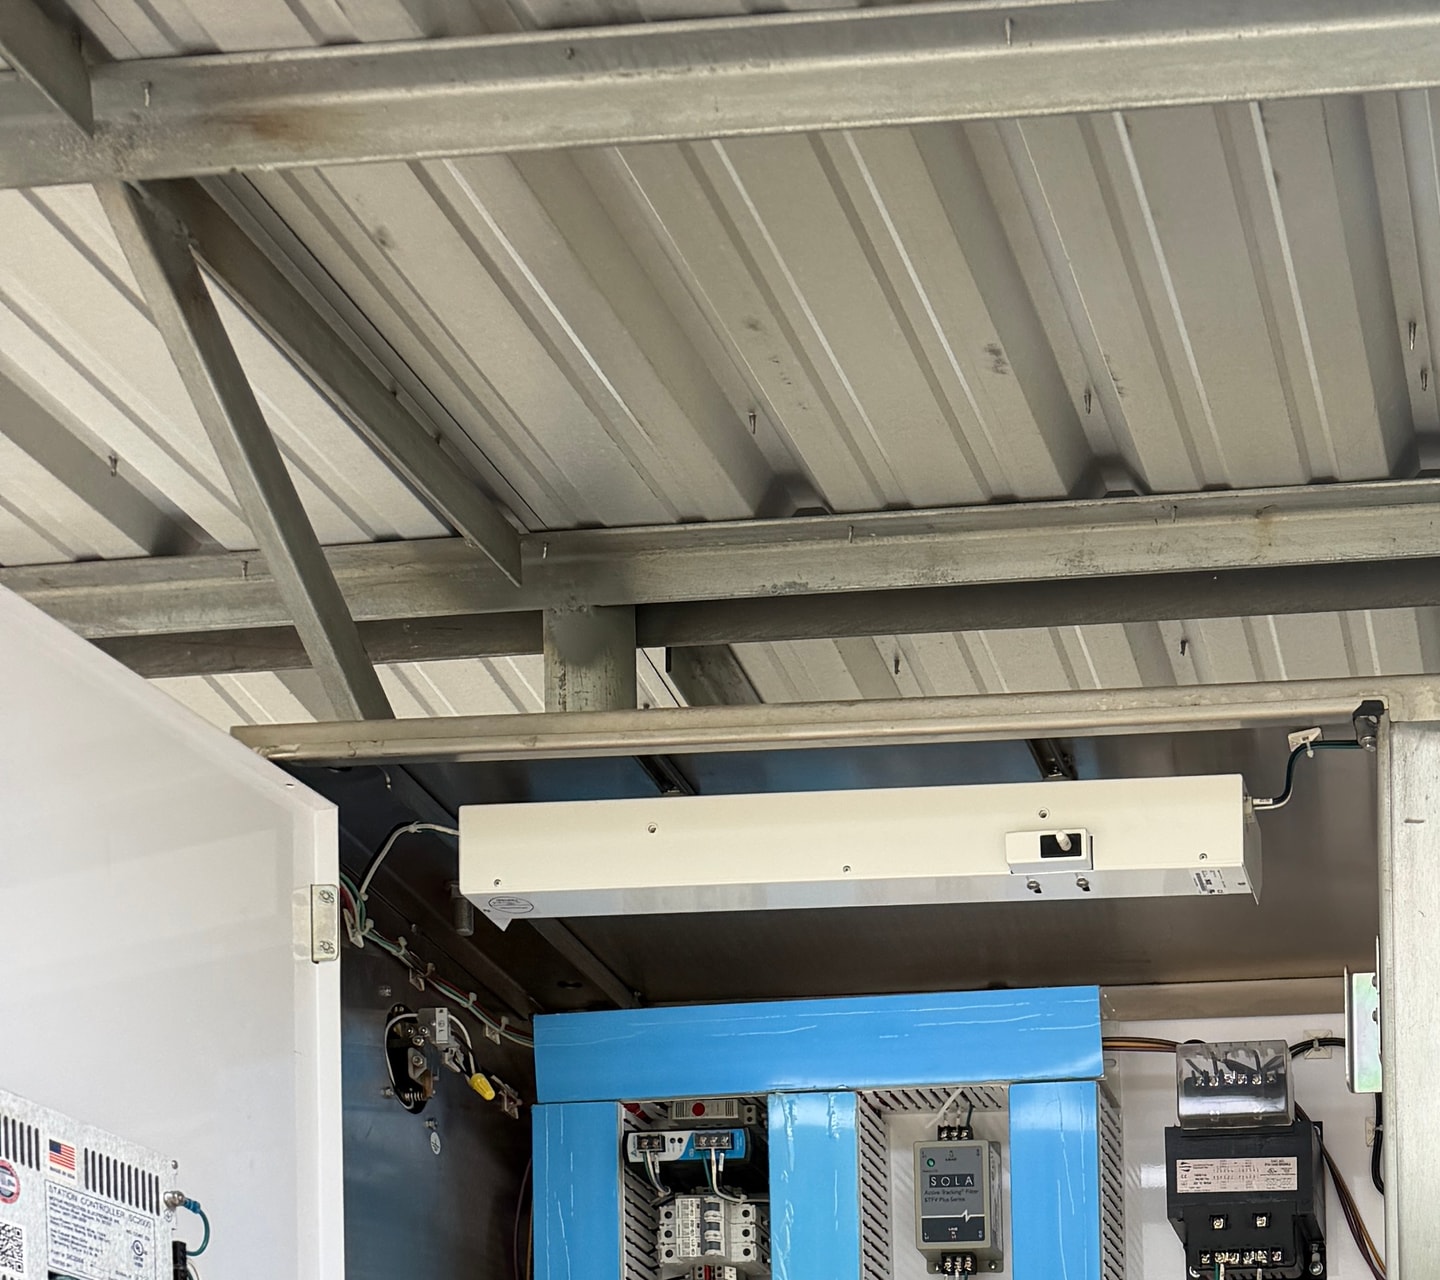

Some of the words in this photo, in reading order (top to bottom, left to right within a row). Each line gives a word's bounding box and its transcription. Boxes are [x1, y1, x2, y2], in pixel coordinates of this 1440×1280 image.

[931, 1176, 973, 1186] SOLA
[49, 1184, 78, 1202] STATION
[80, 1197, 125, 1217] CONTROLLER
